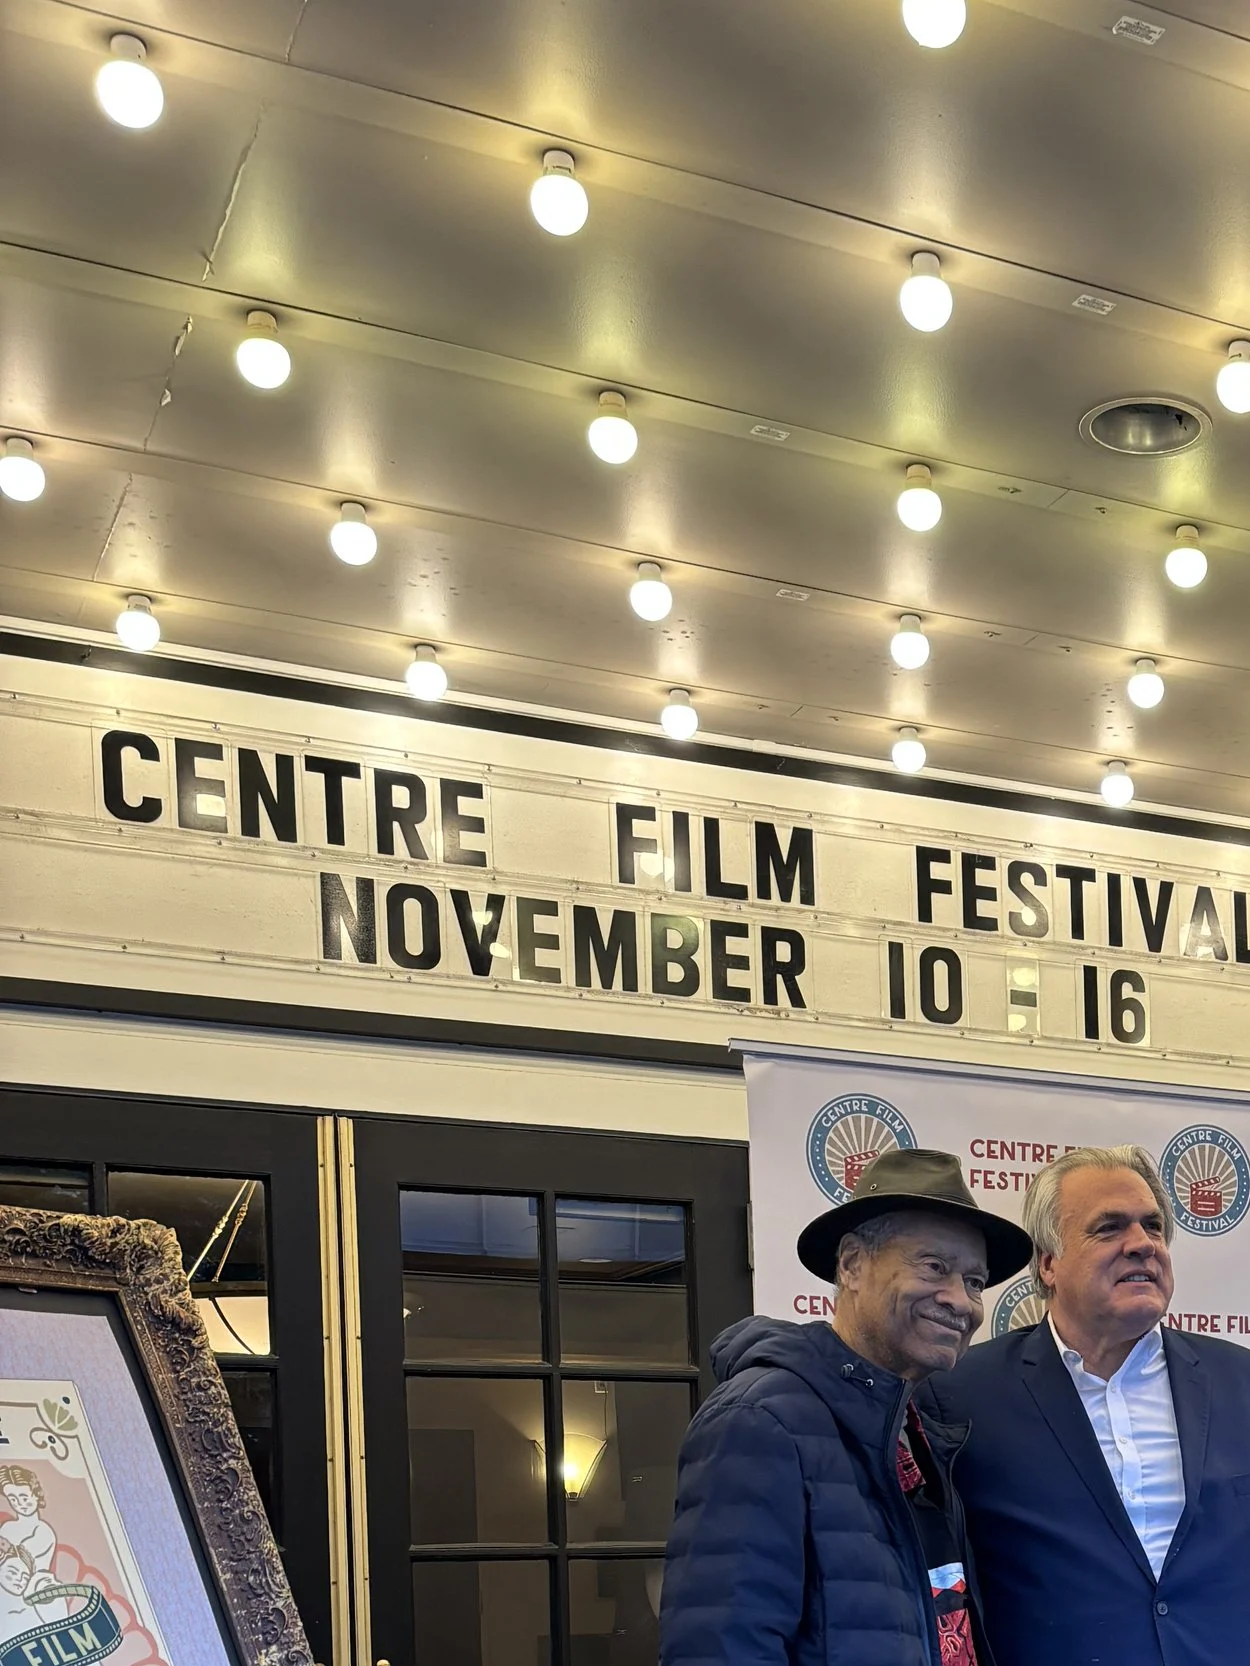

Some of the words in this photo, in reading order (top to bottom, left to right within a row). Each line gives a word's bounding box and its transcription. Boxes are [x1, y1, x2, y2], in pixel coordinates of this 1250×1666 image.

[102, 730, 487, 867] CENTRE
[616, 803, 814, 905] FILM
[320, 872, 806, 1008] NOVEMBER
[888, 941, 963, 1024] 10
[1084, 965, 1145, 1043] 16
[822, 1099, 869, 1128] CENTRE
[875, 1105, 904, 1133] FILM
[969, 1139, 1057, 1163] CENTRE
[1172, 1130, 1213, 1156] CENTRE
[1218, 1134, 1241, 1160] FILM
[970, 1169, 1036, 1191] FESTI
[1180, 1211, 1235, 1231] FESTIVAL
